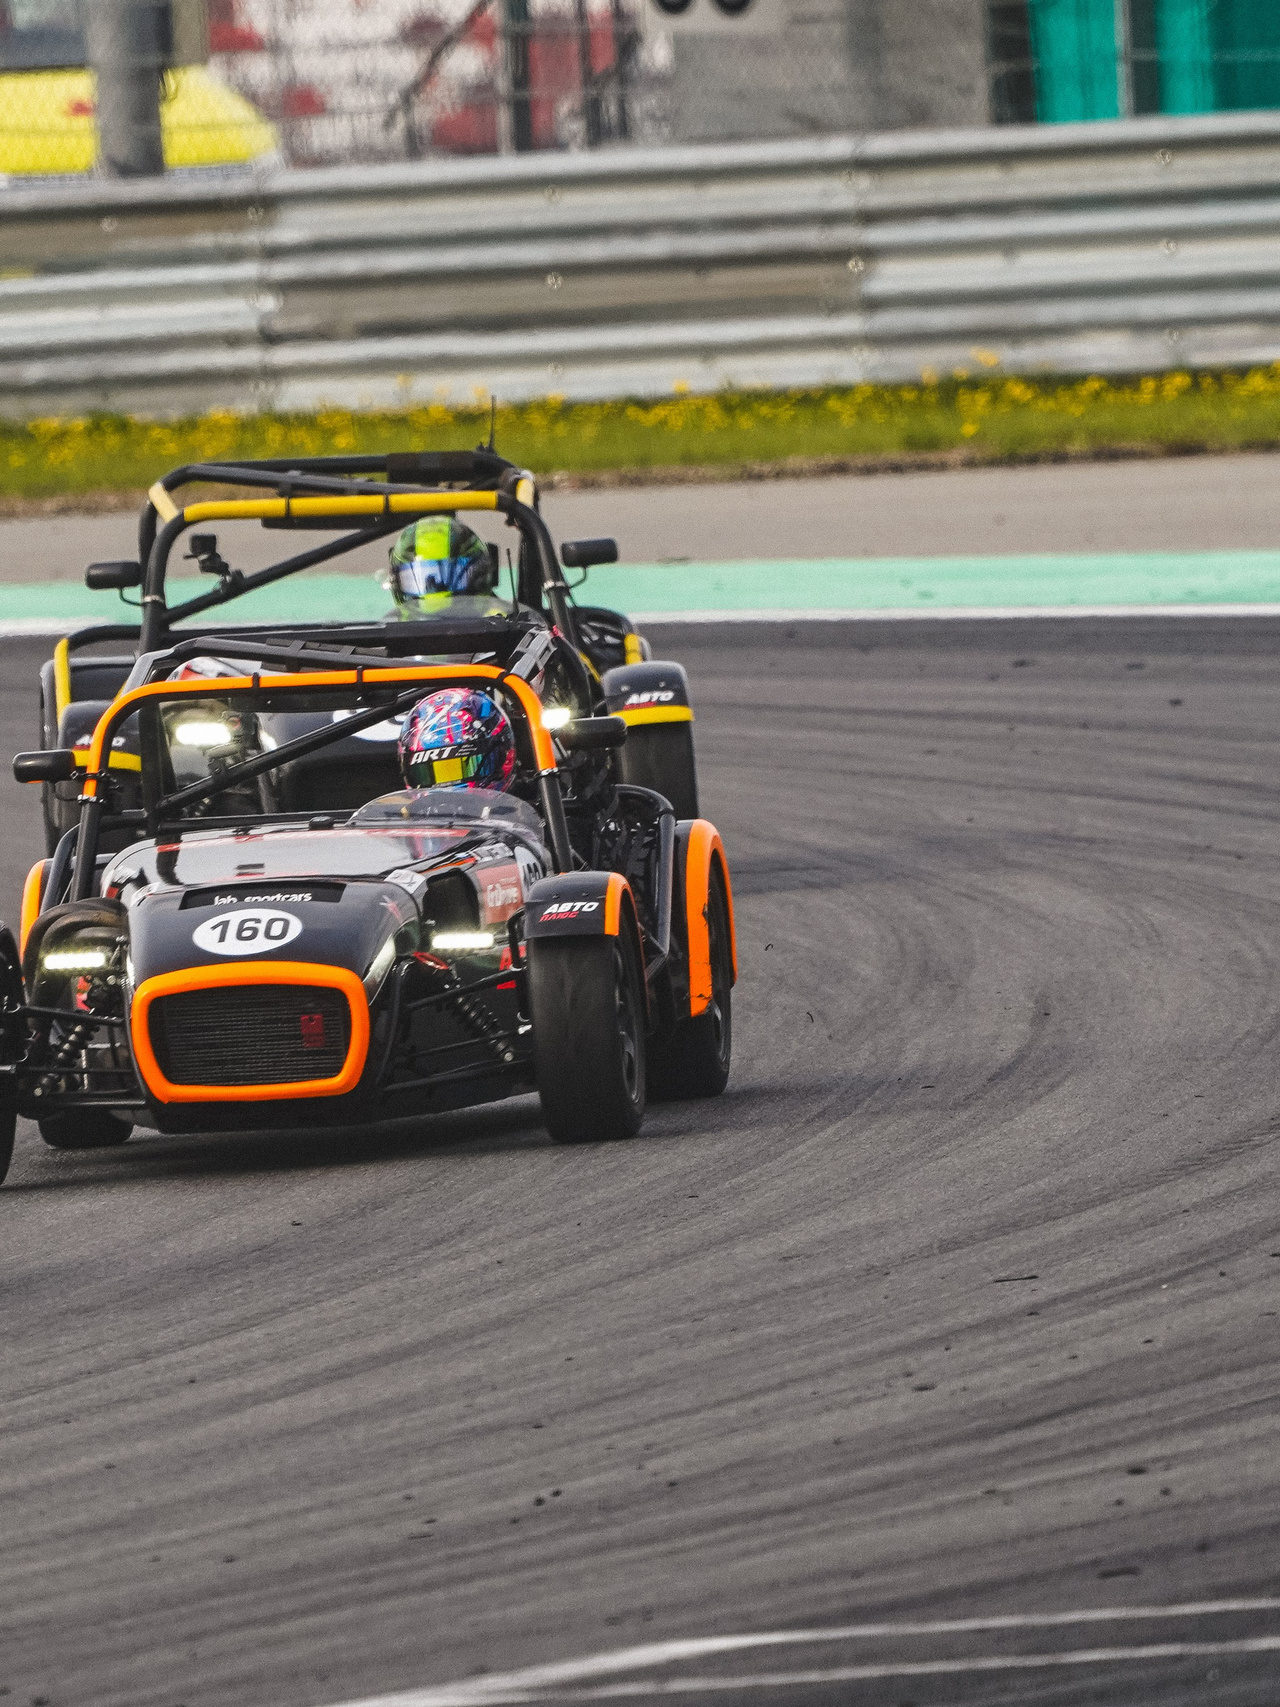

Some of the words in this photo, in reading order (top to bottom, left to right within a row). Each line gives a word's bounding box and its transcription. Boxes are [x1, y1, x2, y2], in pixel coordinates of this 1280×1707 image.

[410, 745, 458, 766] ART
[543, 901, 600, 915] АВТО
[210, 917, 290, 943] 160
